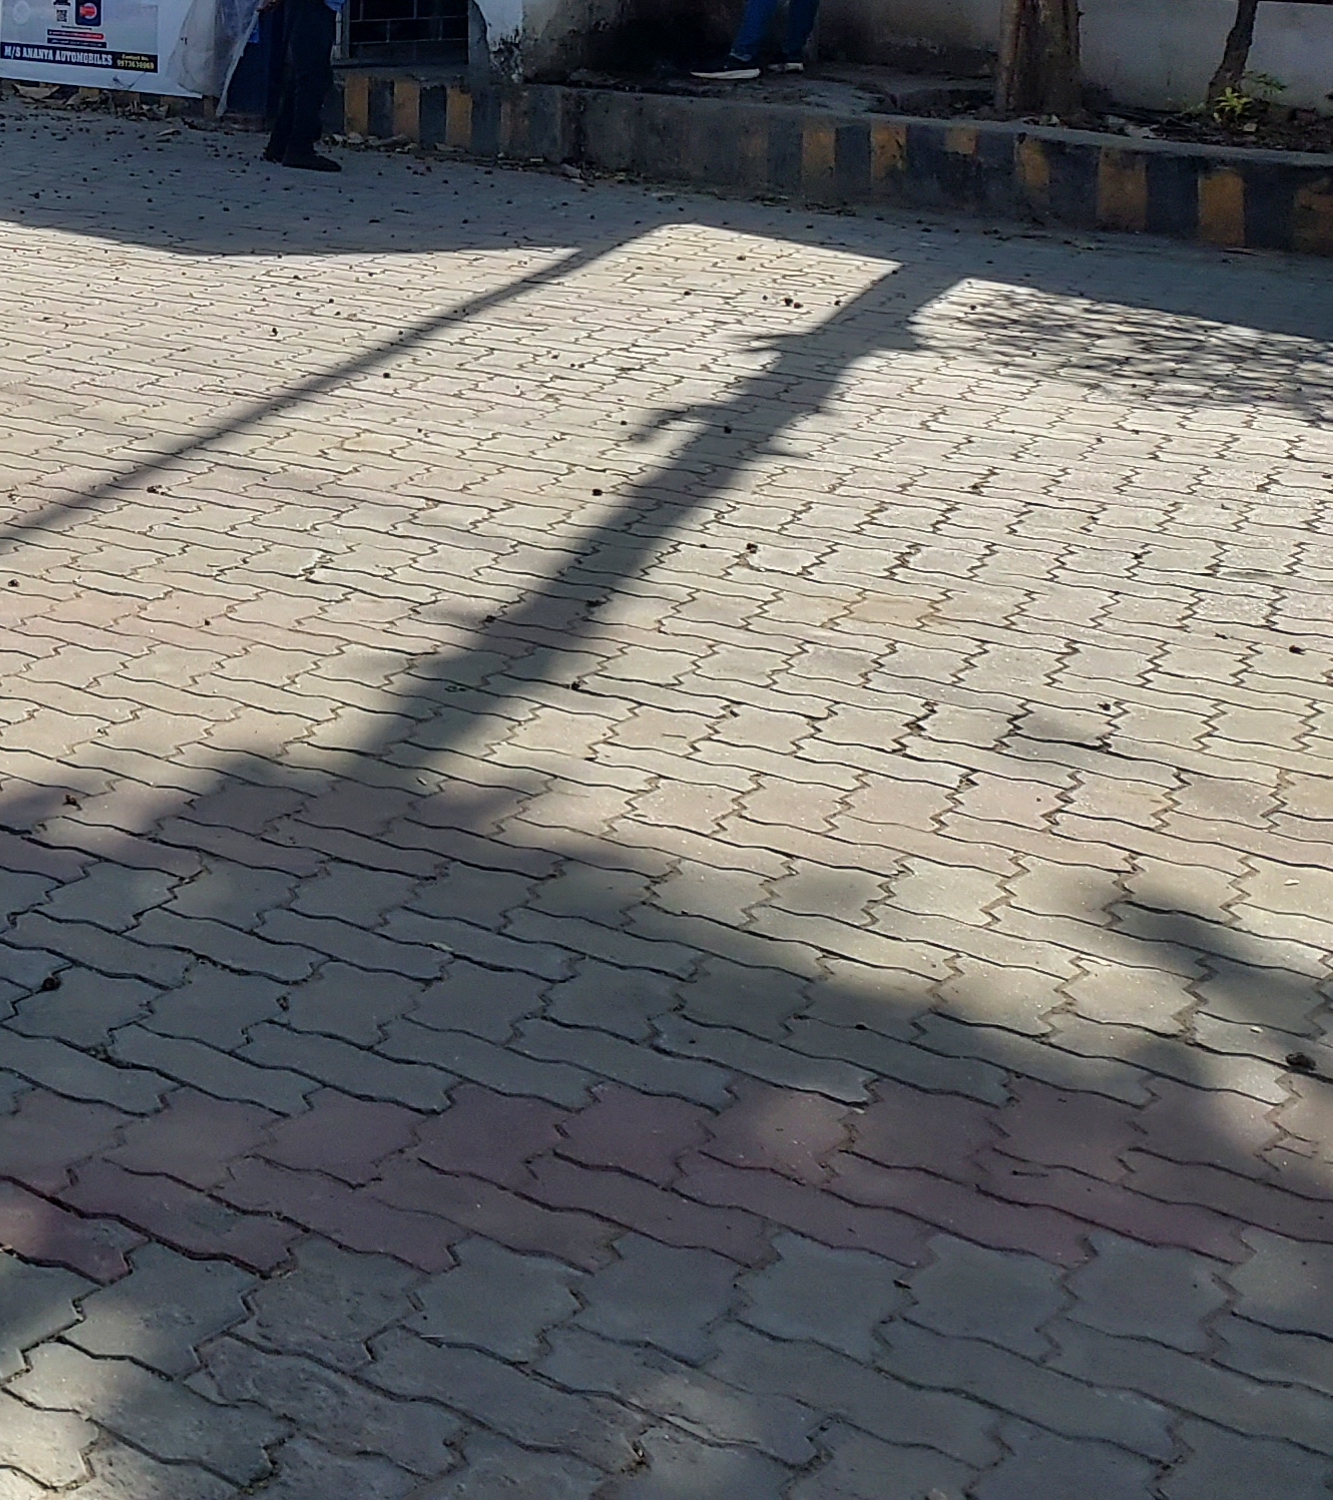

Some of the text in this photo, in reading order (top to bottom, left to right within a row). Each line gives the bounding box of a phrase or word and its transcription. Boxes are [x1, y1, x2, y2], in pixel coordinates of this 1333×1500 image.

[4, 46, 113, 66] M/S ANANYA AUTOMOBILES
